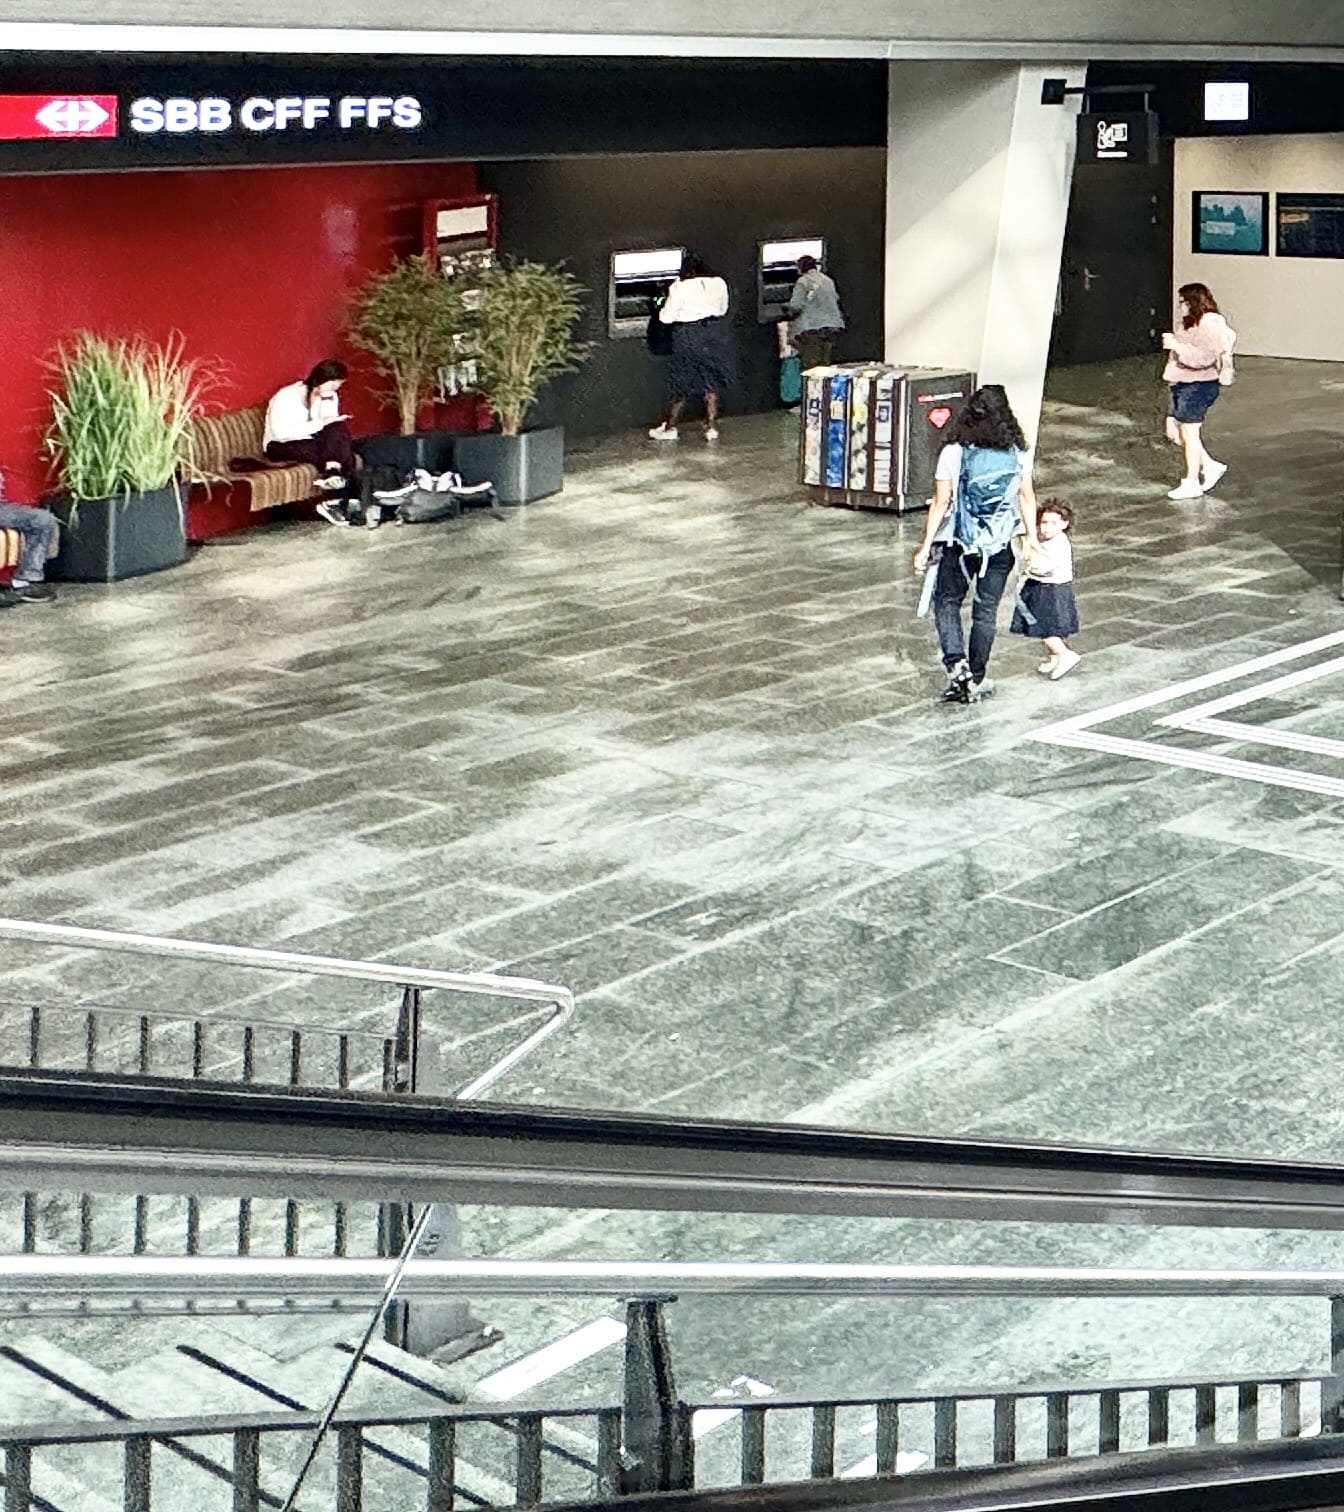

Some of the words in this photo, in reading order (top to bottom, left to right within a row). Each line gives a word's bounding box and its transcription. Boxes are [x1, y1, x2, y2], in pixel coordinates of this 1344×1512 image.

[130, 97, 232, 132] SBB
[240, 97, 331, 131] CFF
[339, 96, 422, 128] FFS
